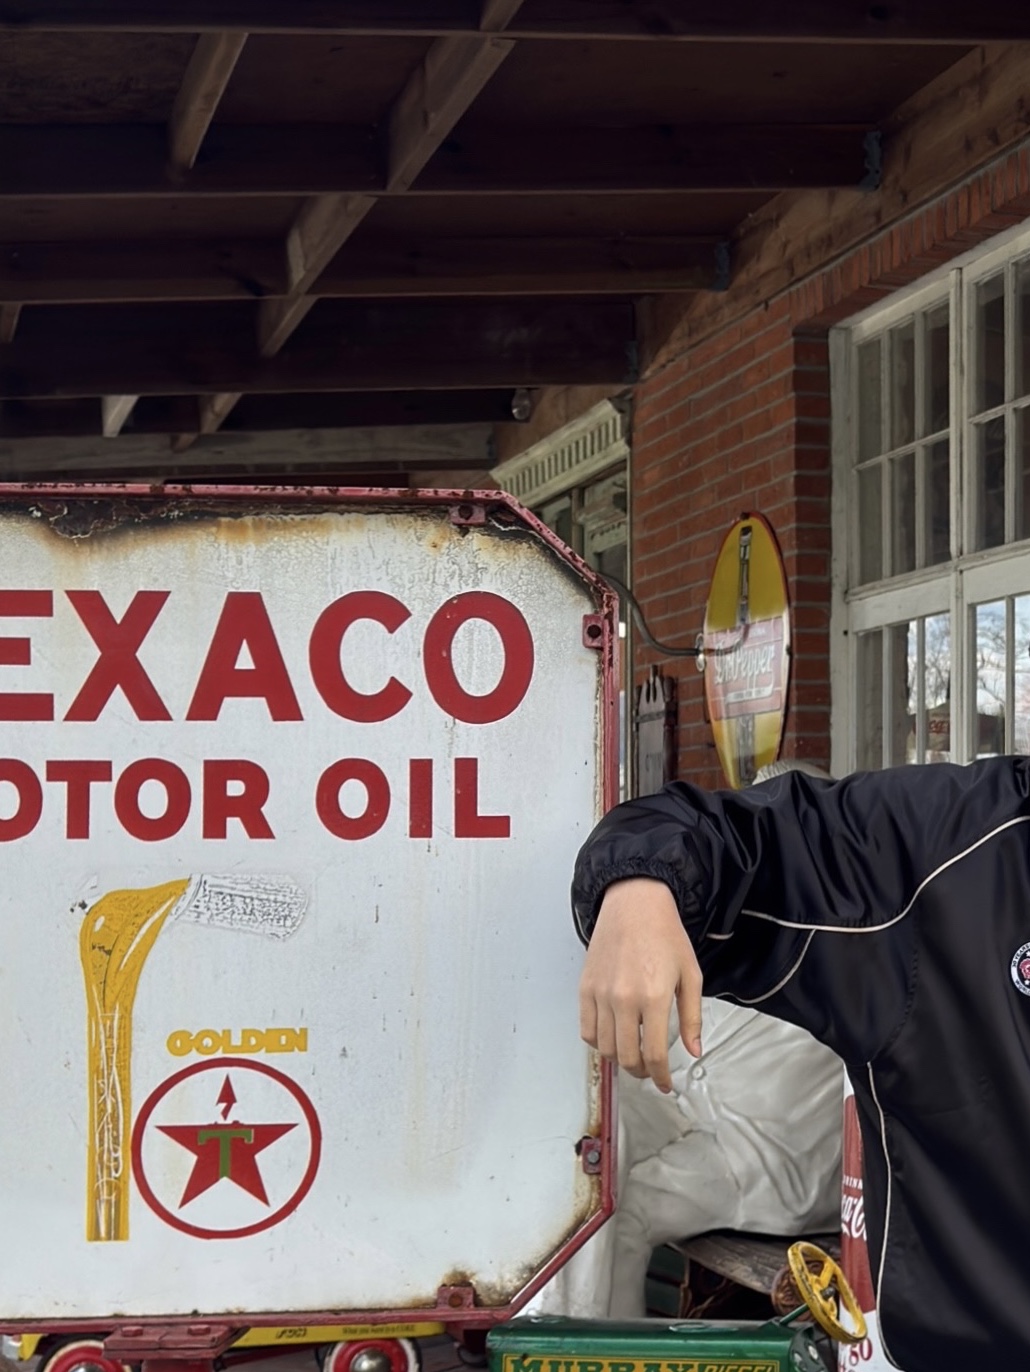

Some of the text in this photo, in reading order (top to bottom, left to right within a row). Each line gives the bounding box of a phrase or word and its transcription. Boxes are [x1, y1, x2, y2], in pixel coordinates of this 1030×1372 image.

[0, 757, 511, 841] OTOR OIL
[166, 1028, 308, 1057] GOLDEN
